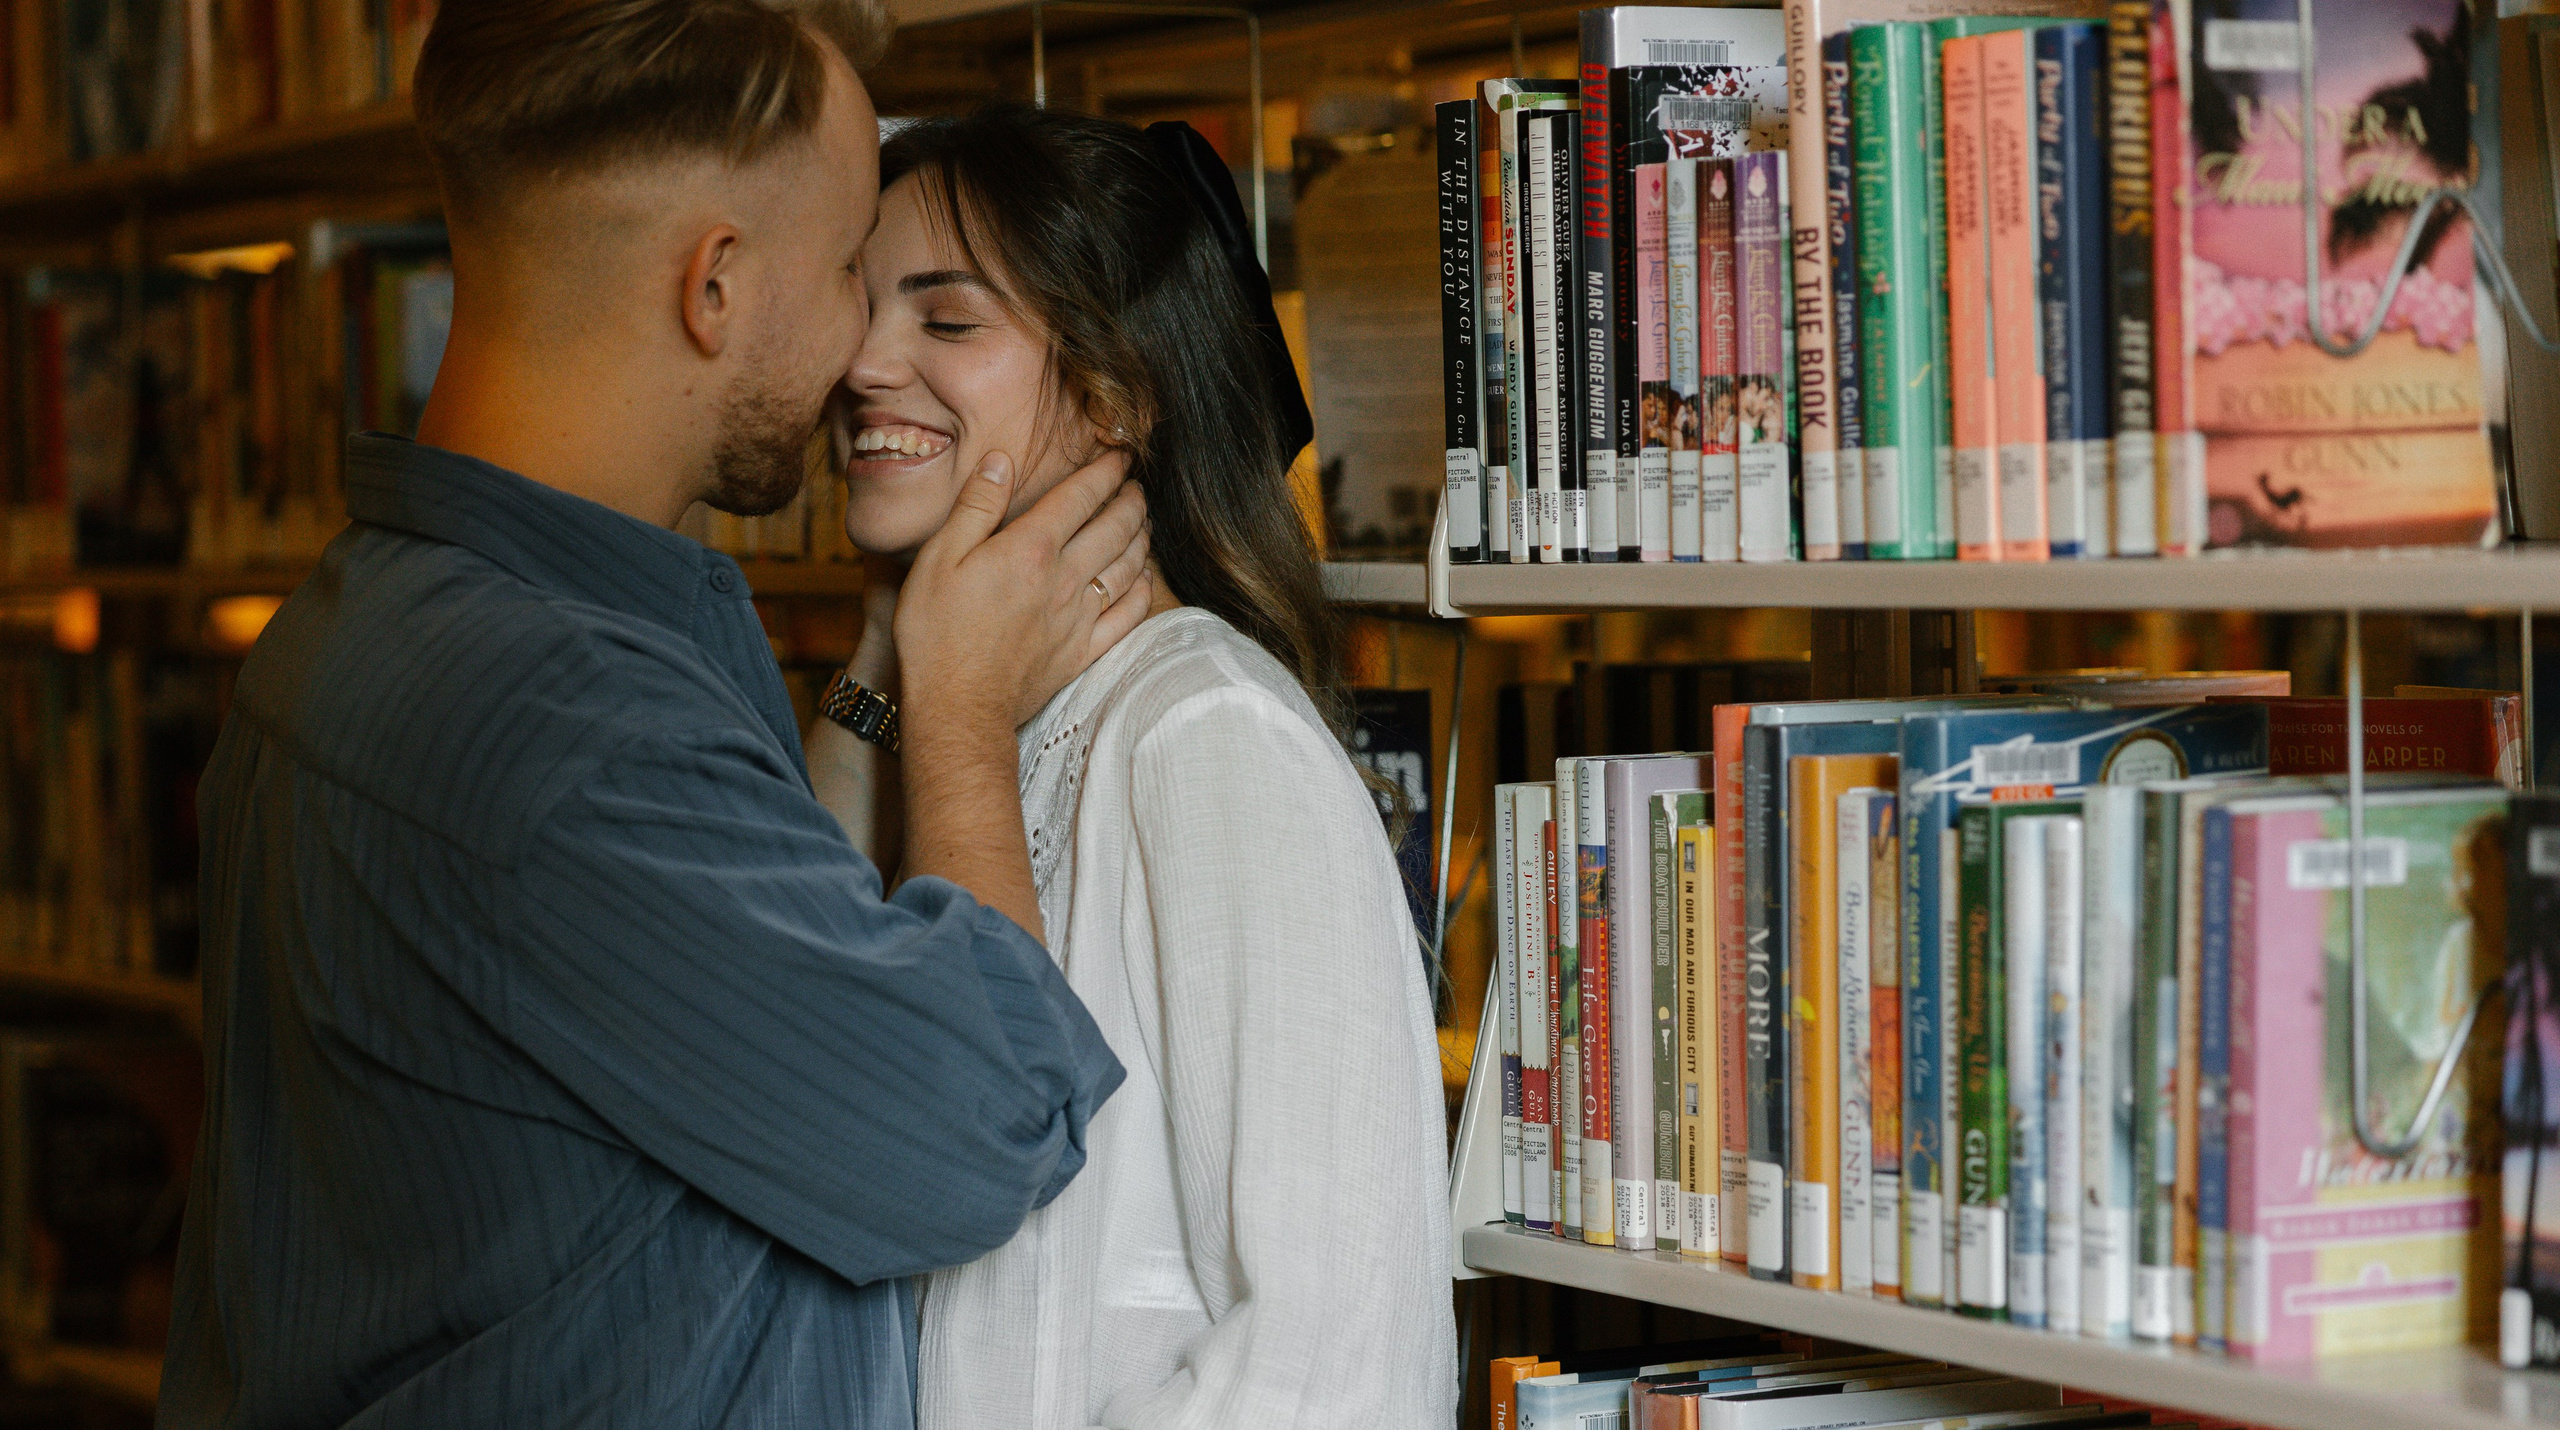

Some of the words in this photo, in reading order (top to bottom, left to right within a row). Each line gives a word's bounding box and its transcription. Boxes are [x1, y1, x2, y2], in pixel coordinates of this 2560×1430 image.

[1790, 4, 1807, 115] GUILLORY
[1670, 120, 1676, 128] 3
[1681, 121, 1700, 129] 1168
[1705, 121, 1728, 130] 12724
[1823, 61, 1851, 146] Party
[1454, 117, 1466, 145] IN
[1581, 63, 1610, 239] OVERWATCH
[1456, 157, 1467, 205] THE
[1561, 149, 1569, 213] OLIVIER
[1828, 151, 1850, 179] of
[1441, 170, 1453, 234] WITH
[1502, 157, 1513, 224] Revolution
[1827, 182, 1850, 247] Two
[1487, 250, 1503, 258] WAS
[1554, 184, 1564, 318] DISAPPEARANCE
[1562, 217, 1571, 261] GUEZ
[1795, 227, 1822, 265] BY
[1443, 248, 1455, 296] YOU
[1457, 219, 1471, 345] DISTANCE
[1486, 273, 1503, 281] NEVE
[1505, 227, 1517, 315] SUNDAY
[1489, 295, 1503, 304] THE
[1588, 271, 1604, 321] MARC
[1796, 276, 1823, 334] THE
[1557, 321, 1565, 342] OF
[1835, 290, 1856, 378] Jasmine
[1455, 360, 1465, 404] Carla
[1508, 340, 1517, 393] WENDY
[1558, 346, 1566, 391] JOSEF
[1588, 328, 1606, 440] GUGGENHEIM
[1799, 349, 1828, 429] BOOK
[1510, 401, 1518, 462] GUERRA
[1560, 398, 1568, 472] MENGELE
[1621, 399, 1630, 437] PUJA
[1447, 453, 1470, 461] Central
[2312, 723, 2334, 735] FOR
[2364, 724, 2406, 736] NOVELS
[2409, 723, 2424, 735] OF
[2271, 744, 2336, 766] AREN
[2366, 746, 2447, 769] ARPER
[1504, 809, 1512, 834] THE
[1561, 790, 1571, 823] Home
[1581, 766, 1590, 839] GULLEY
[1505, 838, 1513, 867] LAST
[1563, 828, 1570, 840] to
[1654, 818, 1668, 850] THE
[1506, 873, 1515, 910] GREAT
[1547, 850, 1557, 905] GULLEY
[1561, 843, 1572, 940] HARMONY
[1610, 886, 1616, 901] OF
[1686, 881, 1694, 893] IN
[1524, 871, 1534, 961] JOSEPHINE
[1655, 853, 1670, 967] BOATBUILDER
[1686, 899, 1694, 922] OUR
[1507, 916, 1515, 956] DANCE
[1610, 922, 1618, 990] MARRIAGE
[1686, 928, 1695, 955] MAD
[1508, 961, 1515, 976] ON
[1527, 970, 1536, 986] B.
[1582, 966, 1598, 1013] Life
[1686, 960, 1695, 985] AND
[1508, 982, 1516, 1021] EARTH
[1748, 926, 1771, 1060] MORE
[1550, 1000, 1560, 1059] Christmas
[1687, 990, 1696, 1041] FURIOUS
[1583, 1024, 1597, 1084] Goes
[1687, 1047, 1696, 1074] CITY
[1506, 1070, 1516, 1116] GULLA
[1584, 1094, 1598, 1131] On
[1523, 1125, 1546, 1134] Central
[1523, 1140, 1547, 1148] FICTION
[1614, 1085, 1622, 1159] GULLIKSEN
[1523, 1148, 1547, 1156] GULLAND
[1964, 1127, 1988, 1205] GUN
[1497, 1401, 1507, 1430] The
